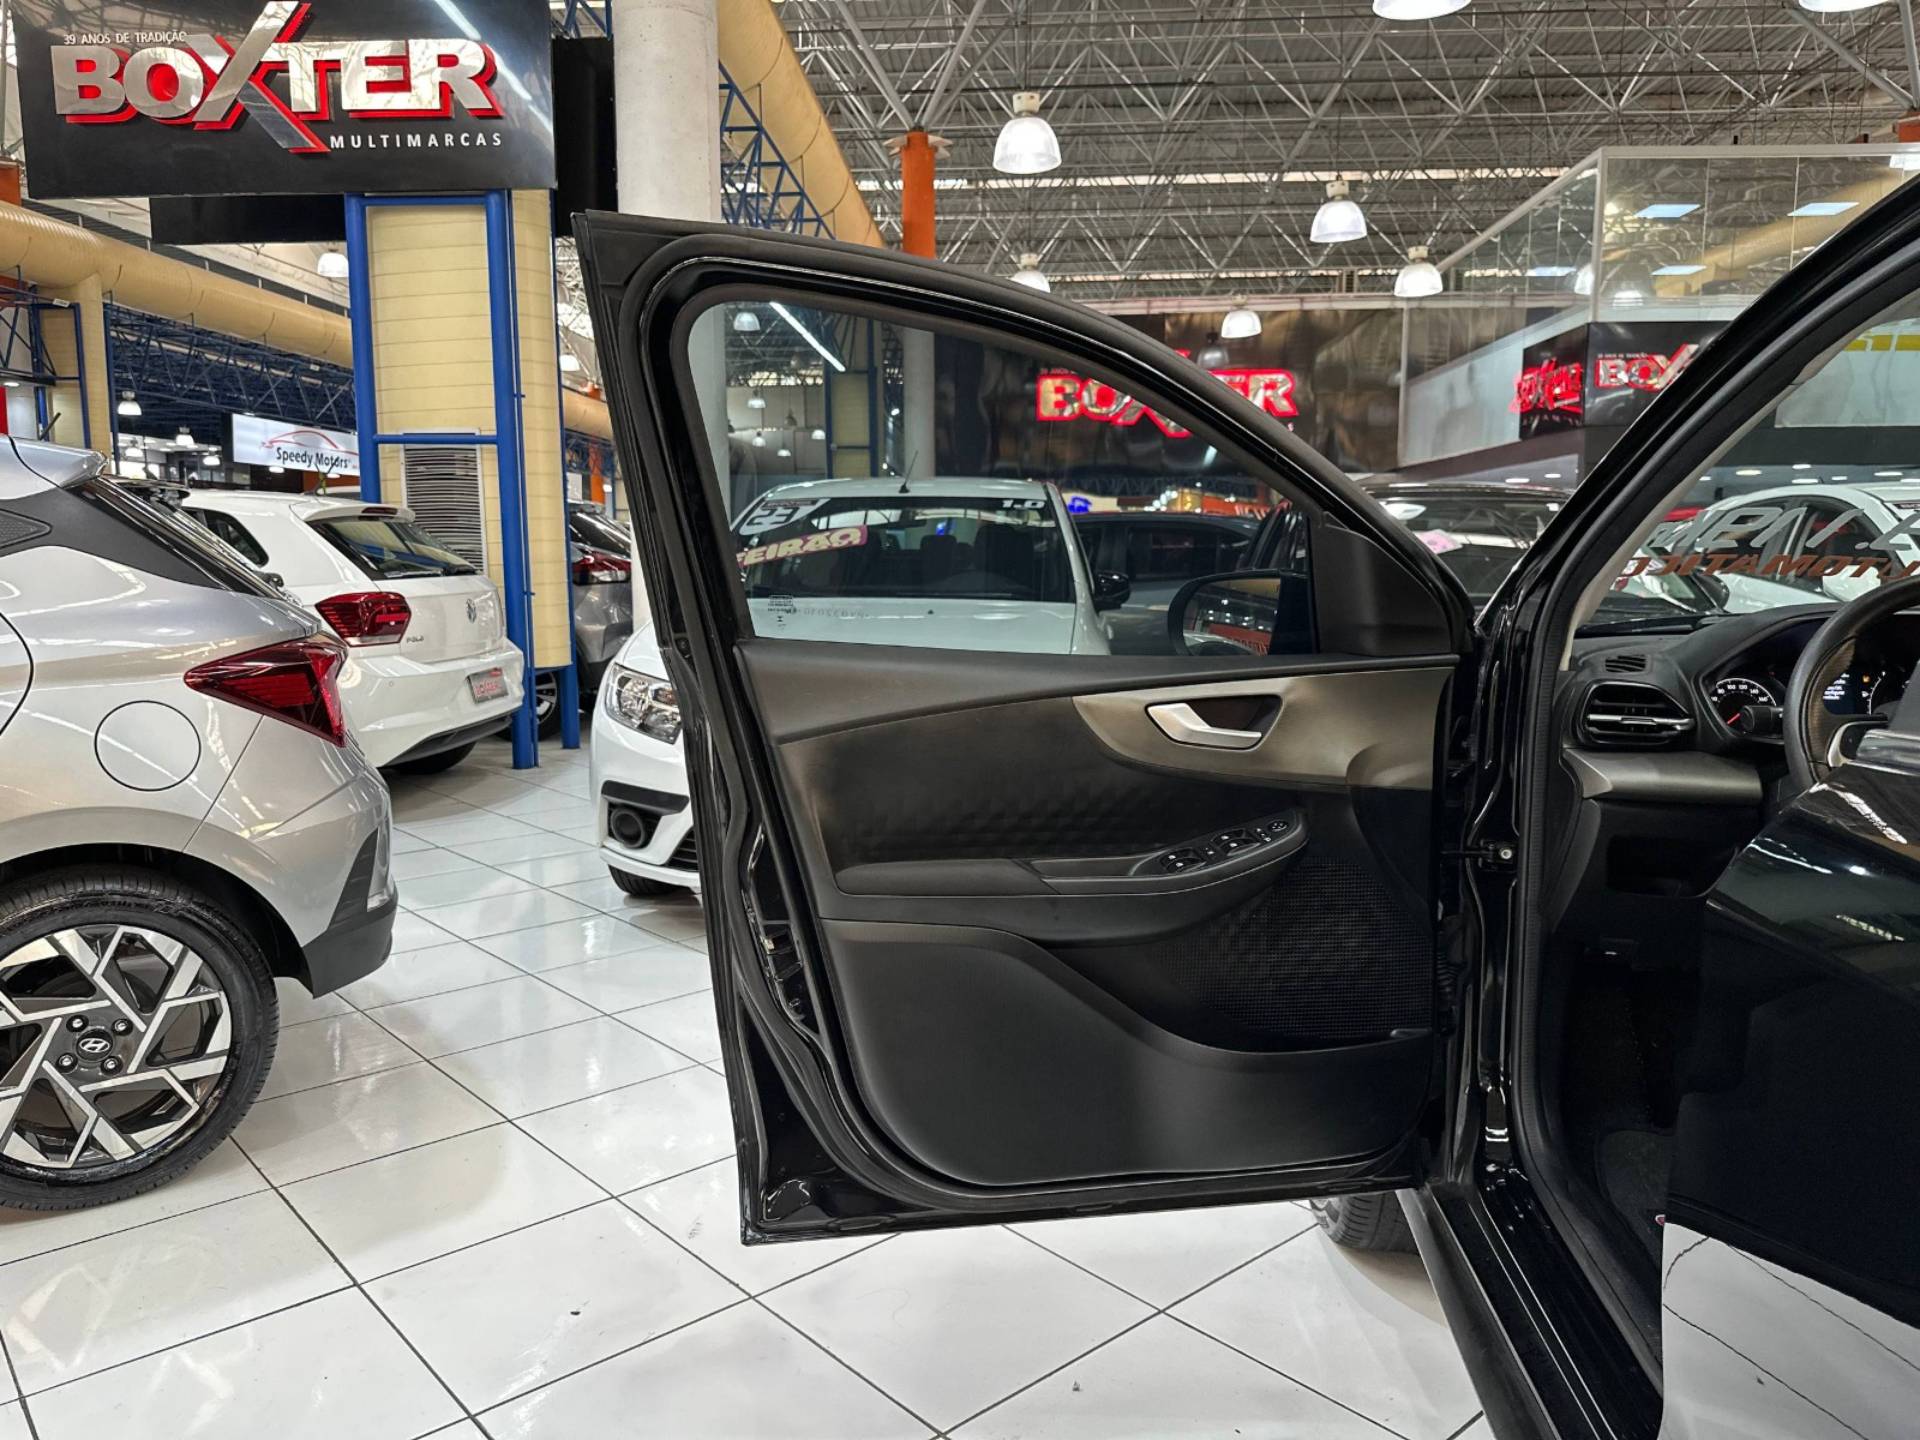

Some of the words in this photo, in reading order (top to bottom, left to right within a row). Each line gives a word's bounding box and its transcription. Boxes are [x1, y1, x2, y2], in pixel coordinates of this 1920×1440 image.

[63, 34, 76, 45] 39
[81, 33, 111, 44] ANOS
[116, 33, 130, 43] DE
[134, 29, 187, 45] TRADIÇÃO
[50, 0, 505, 153] BOXTER
[330, 132, 502, 149] MULTIMARCAS
[276, 446, 314, 468] Speedy
[315, 452, 348, 468] Motors
[1002, 499, 1046, 509] 1.0
[746, 506, 801, 527] 23
